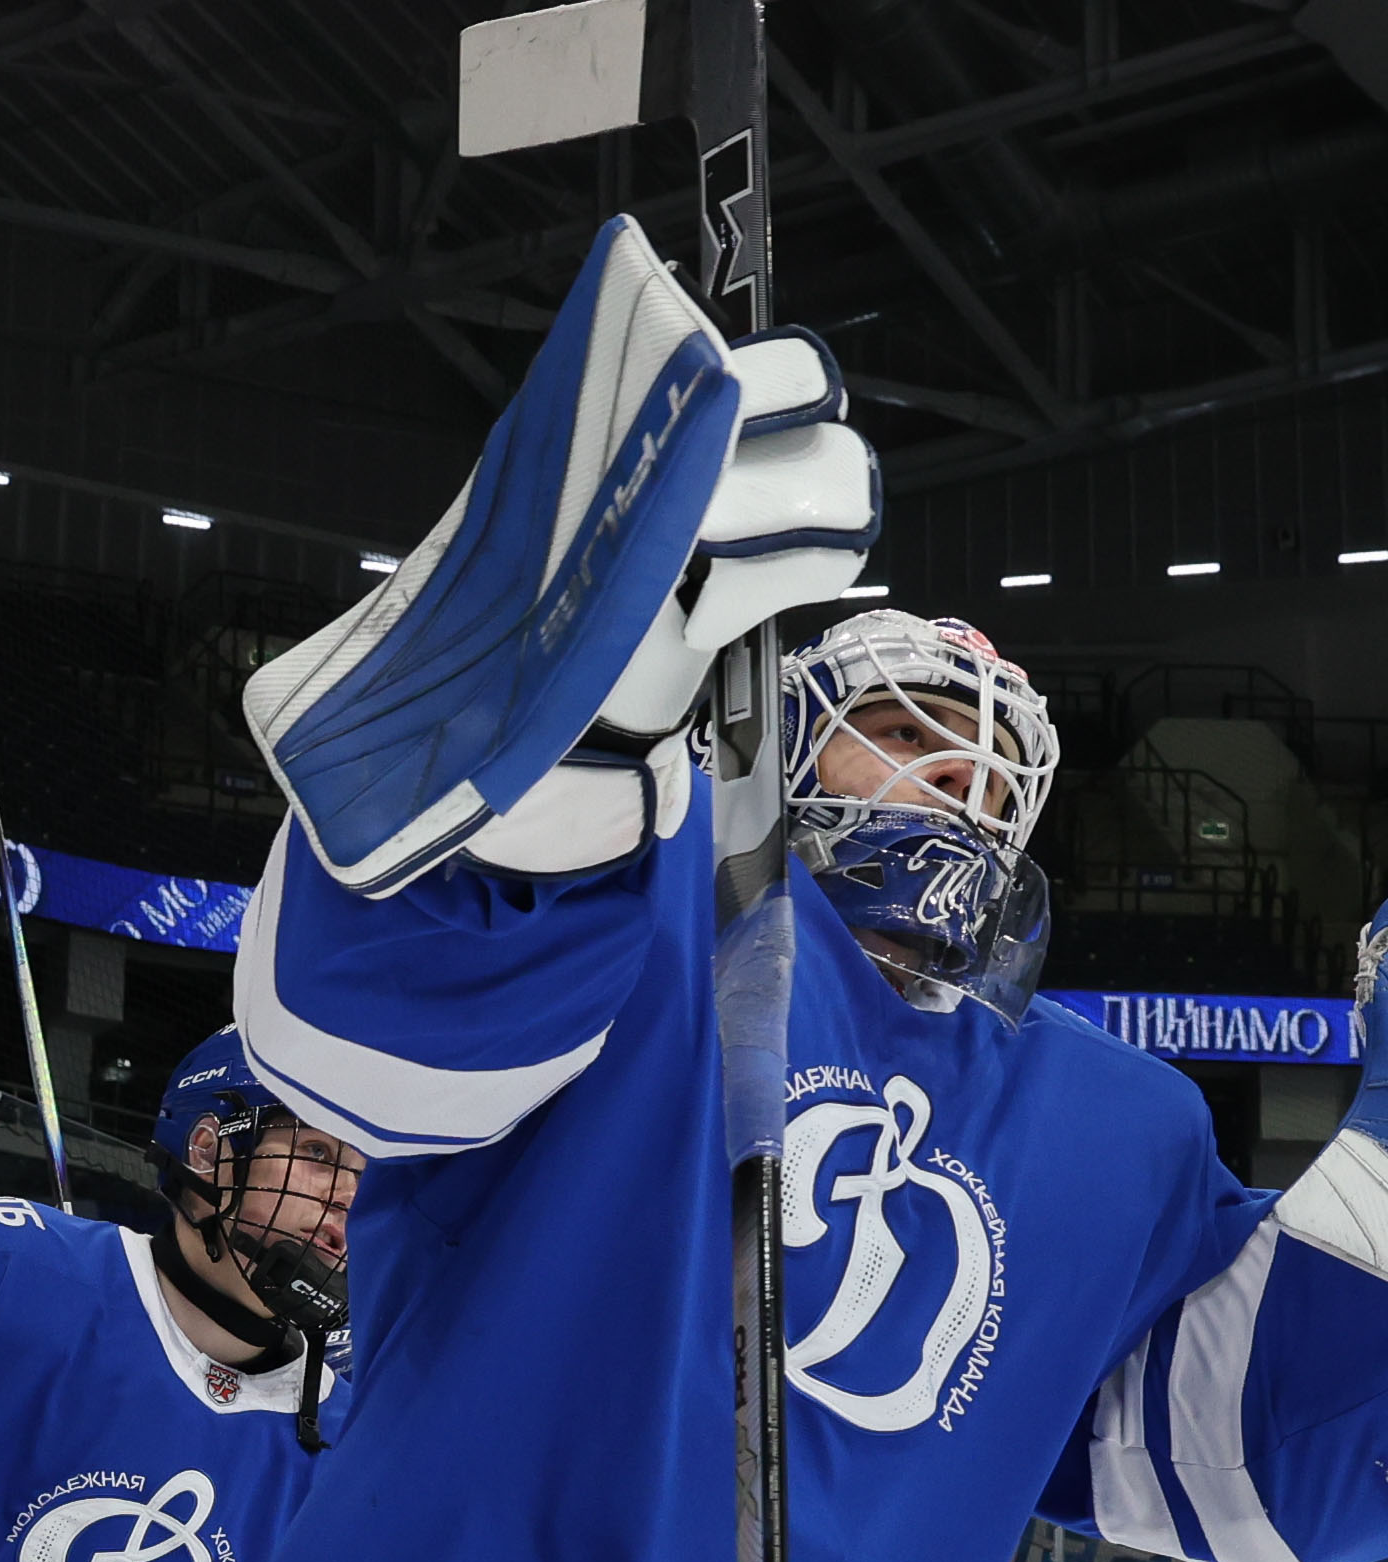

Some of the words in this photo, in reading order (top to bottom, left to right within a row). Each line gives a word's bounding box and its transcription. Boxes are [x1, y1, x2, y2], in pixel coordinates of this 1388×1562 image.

[178, 1066, 228, 1089] CCM
[218, 1121, 252, 1137] CCM
[925, 1146, 1007, 1298] ХОККЕЙНАЯ
[938, 1303, 1005, 1433] КОМАНДА
[5, 1470, 146, 1543] МОЛОДЕЖНАЯ
